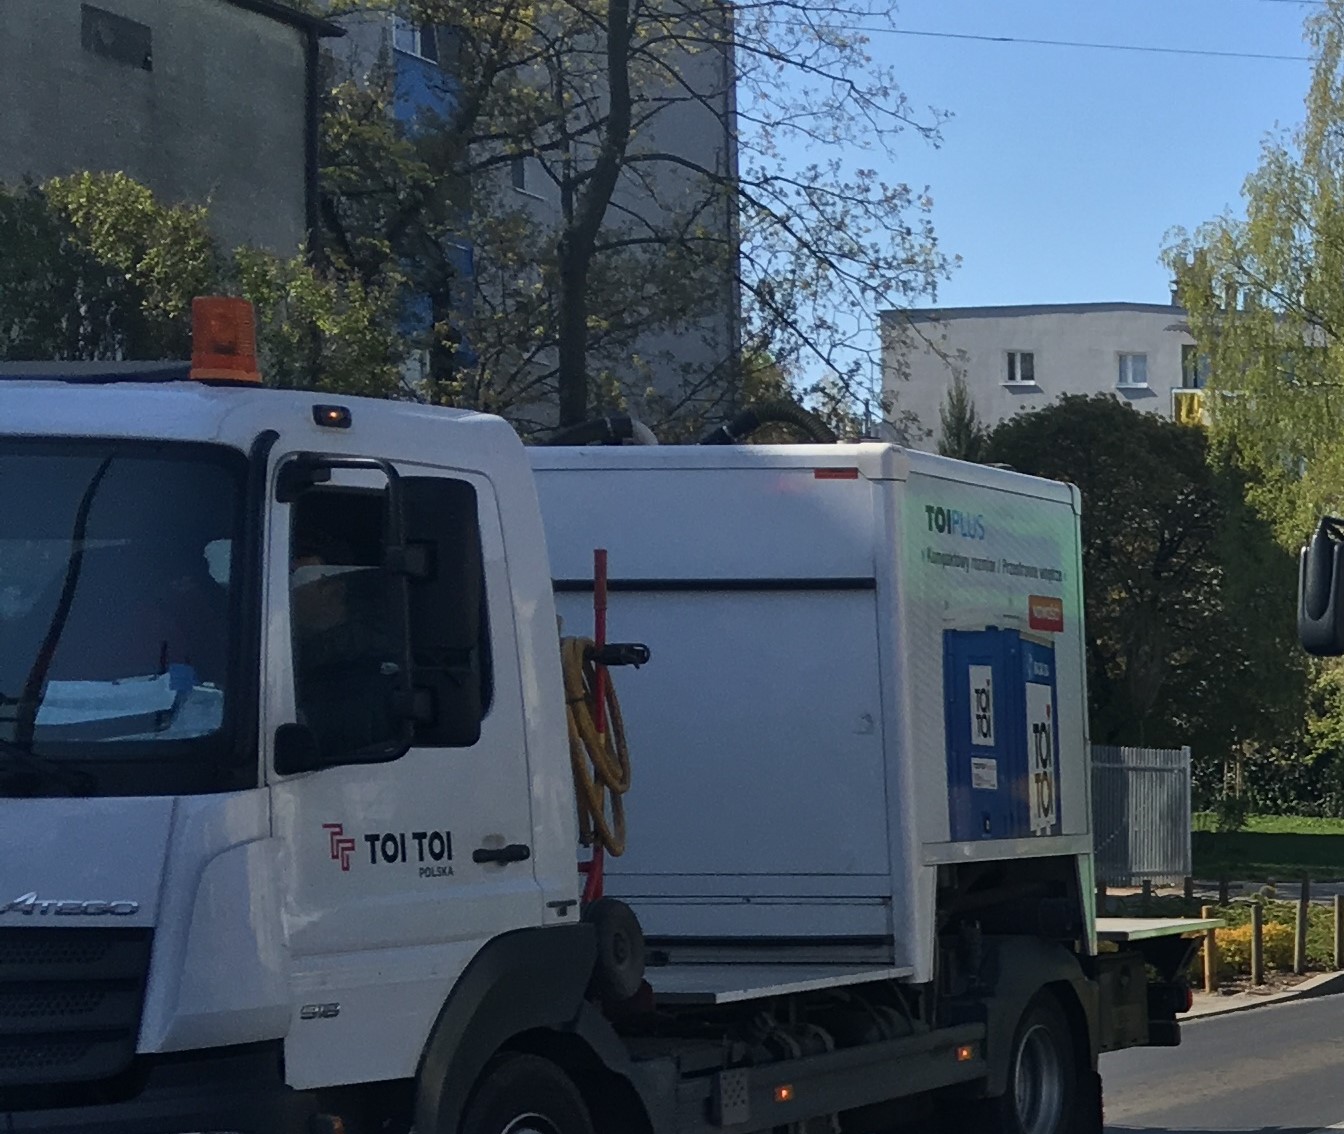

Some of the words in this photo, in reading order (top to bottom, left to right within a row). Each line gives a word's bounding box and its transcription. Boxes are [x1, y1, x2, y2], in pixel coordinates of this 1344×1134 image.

[364, 832, 407, 864] TOI
[412, 831, 453, 862] TOI
[418, 866, 454, 878] POLSKA
[1, 891, 140, 915] ATEGO
